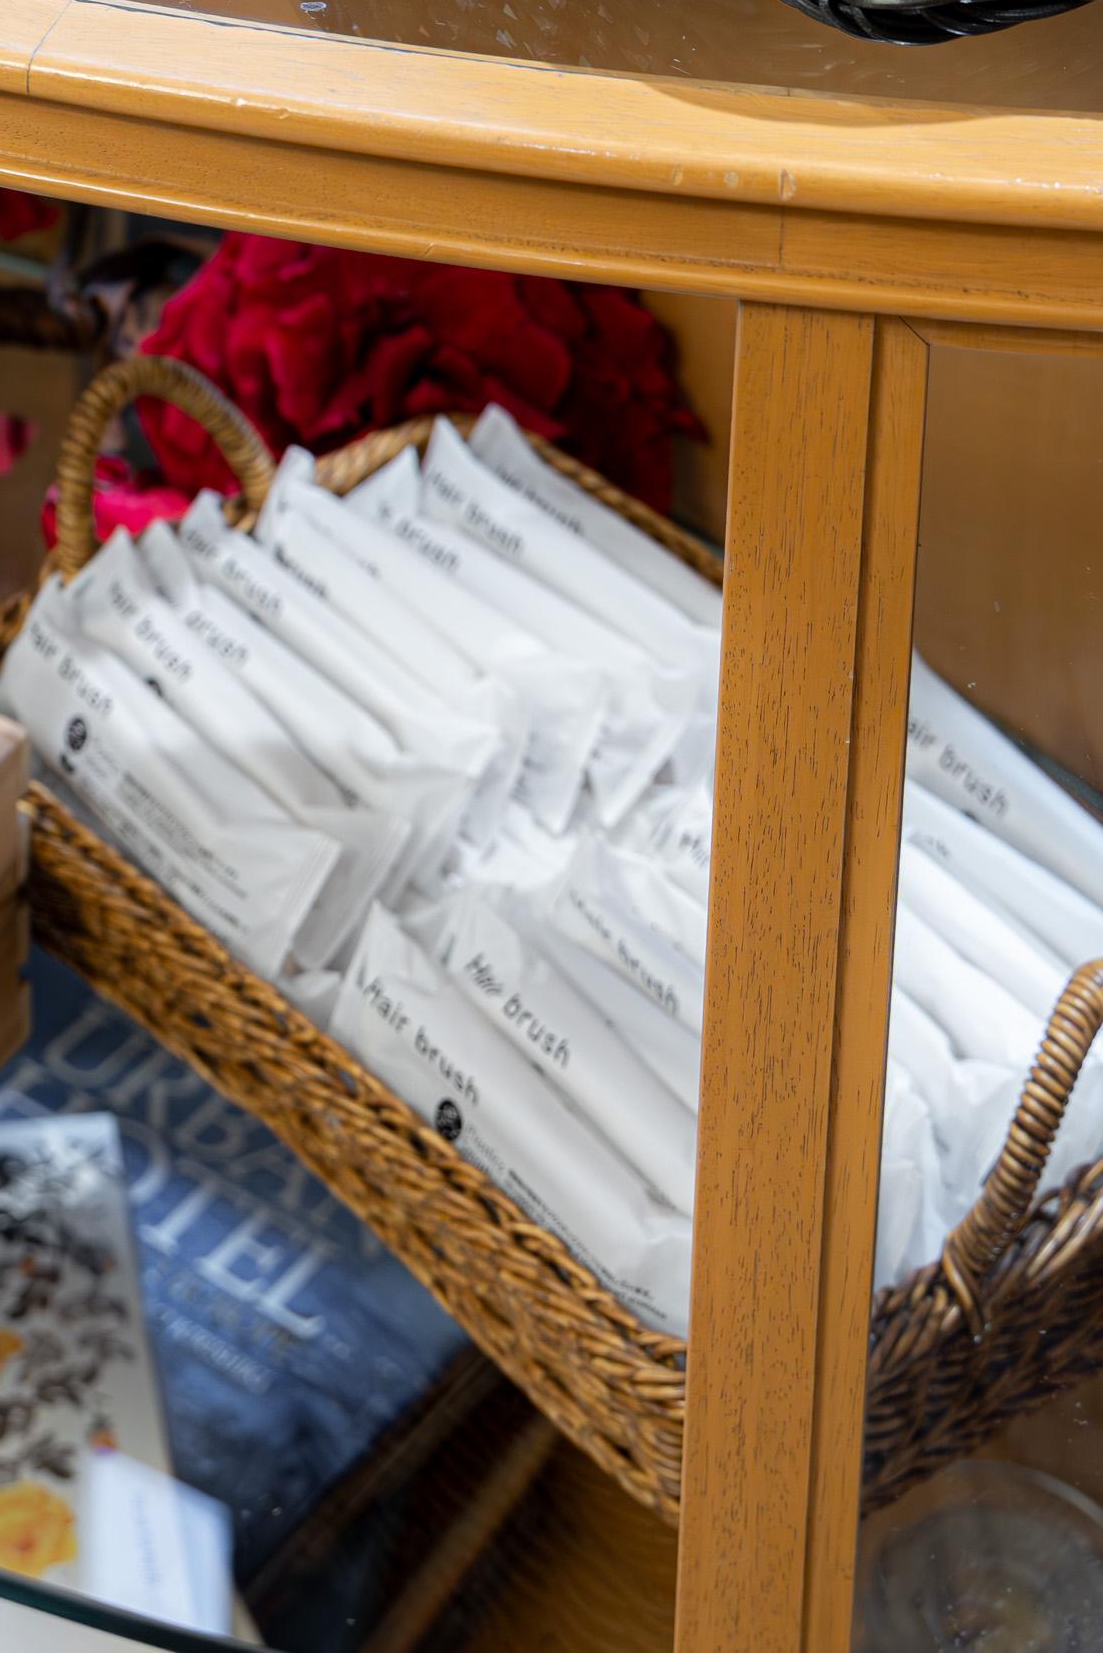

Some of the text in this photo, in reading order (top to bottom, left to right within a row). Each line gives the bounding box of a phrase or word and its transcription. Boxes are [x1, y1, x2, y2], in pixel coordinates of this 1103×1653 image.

[939, 743, 1009, 819] brush
[362, 976, 481, 1108] Hair brush
[502, 991, 573, 1069] brush
